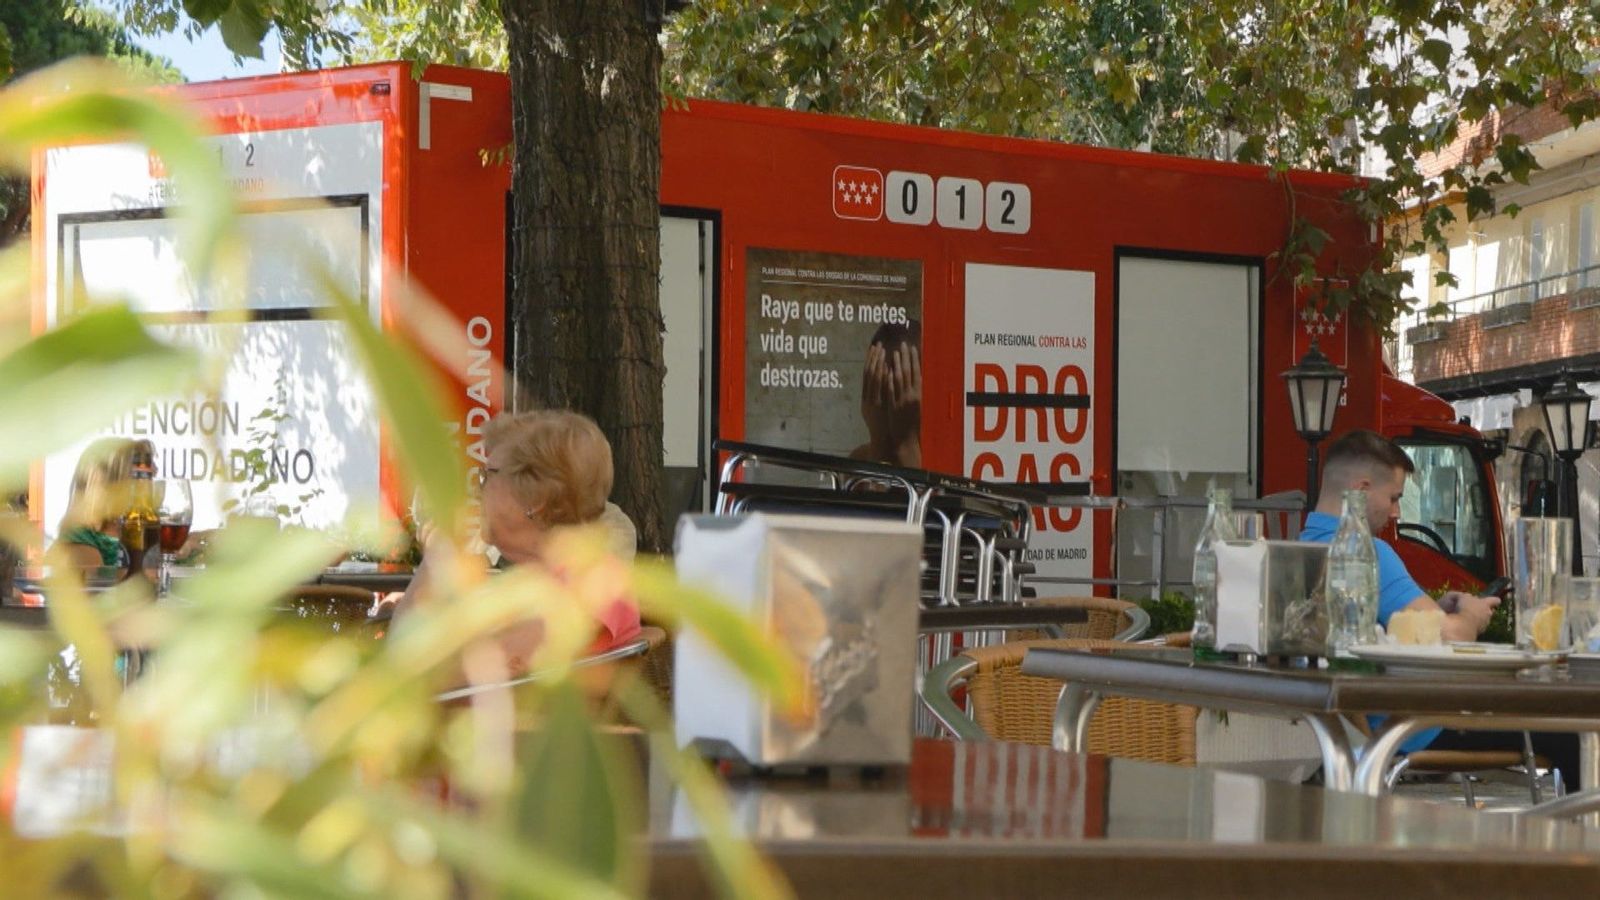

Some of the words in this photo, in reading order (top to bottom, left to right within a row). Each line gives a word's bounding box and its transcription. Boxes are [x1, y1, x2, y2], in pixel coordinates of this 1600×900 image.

[761, 294, 800, 324] Raya
[805, 302, 834, 326] que
[838, 300, 854, 322] te
[859, 303, 911, 329] metes,
[760, 328, 794, 353] vida
[798, 335, 828, 359] que
[974, 333, 996, 345] PLAN
[997, 334, 1037, 347] REGIONAL
[1038, 335, 1070, 348] CONTRA
[1072, 337, 1087, 349] LAS
[760, 362, 844, 389] destrozas.
[974, 363, 1089, 445] DRO
[162, 447, 315, 484] IUDADANO
[1045, 549, 1055, 560] DE
[1057, 548, 1087, 560] MADRID
